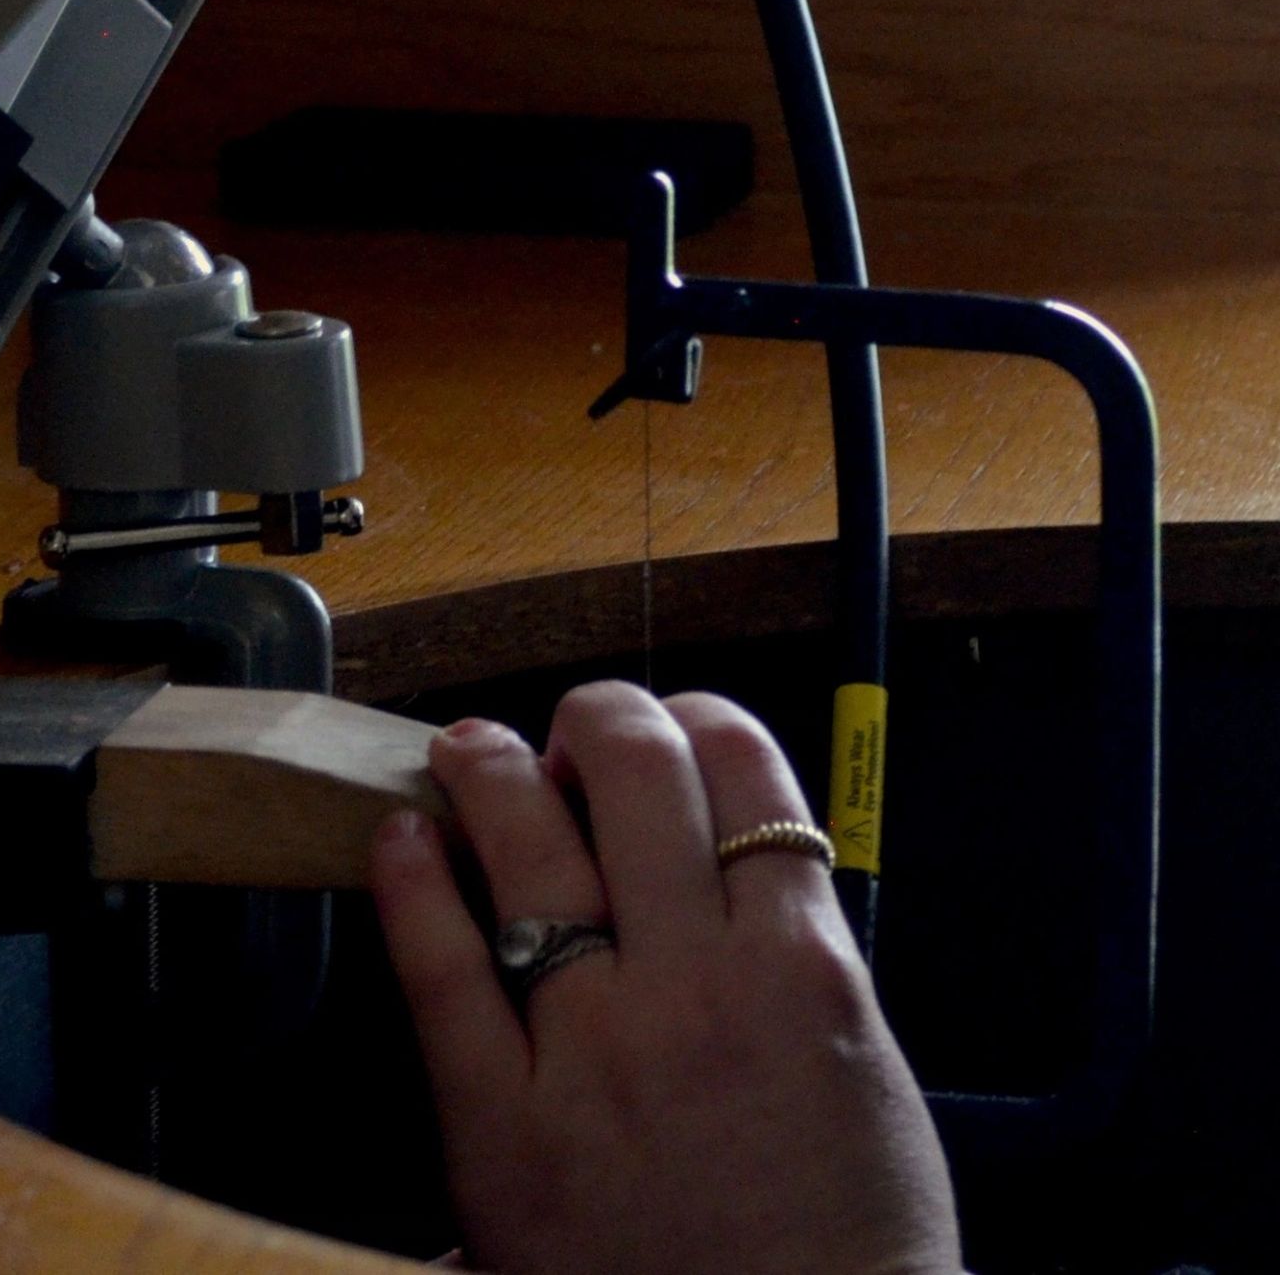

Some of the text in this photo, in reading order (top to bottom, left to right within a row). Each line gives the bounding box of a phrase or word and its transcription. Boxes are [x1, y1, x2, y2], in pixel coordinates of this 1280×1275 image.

[846, 729, 864, 809] Always Wear
[863, 790, 875, 813] Eye
